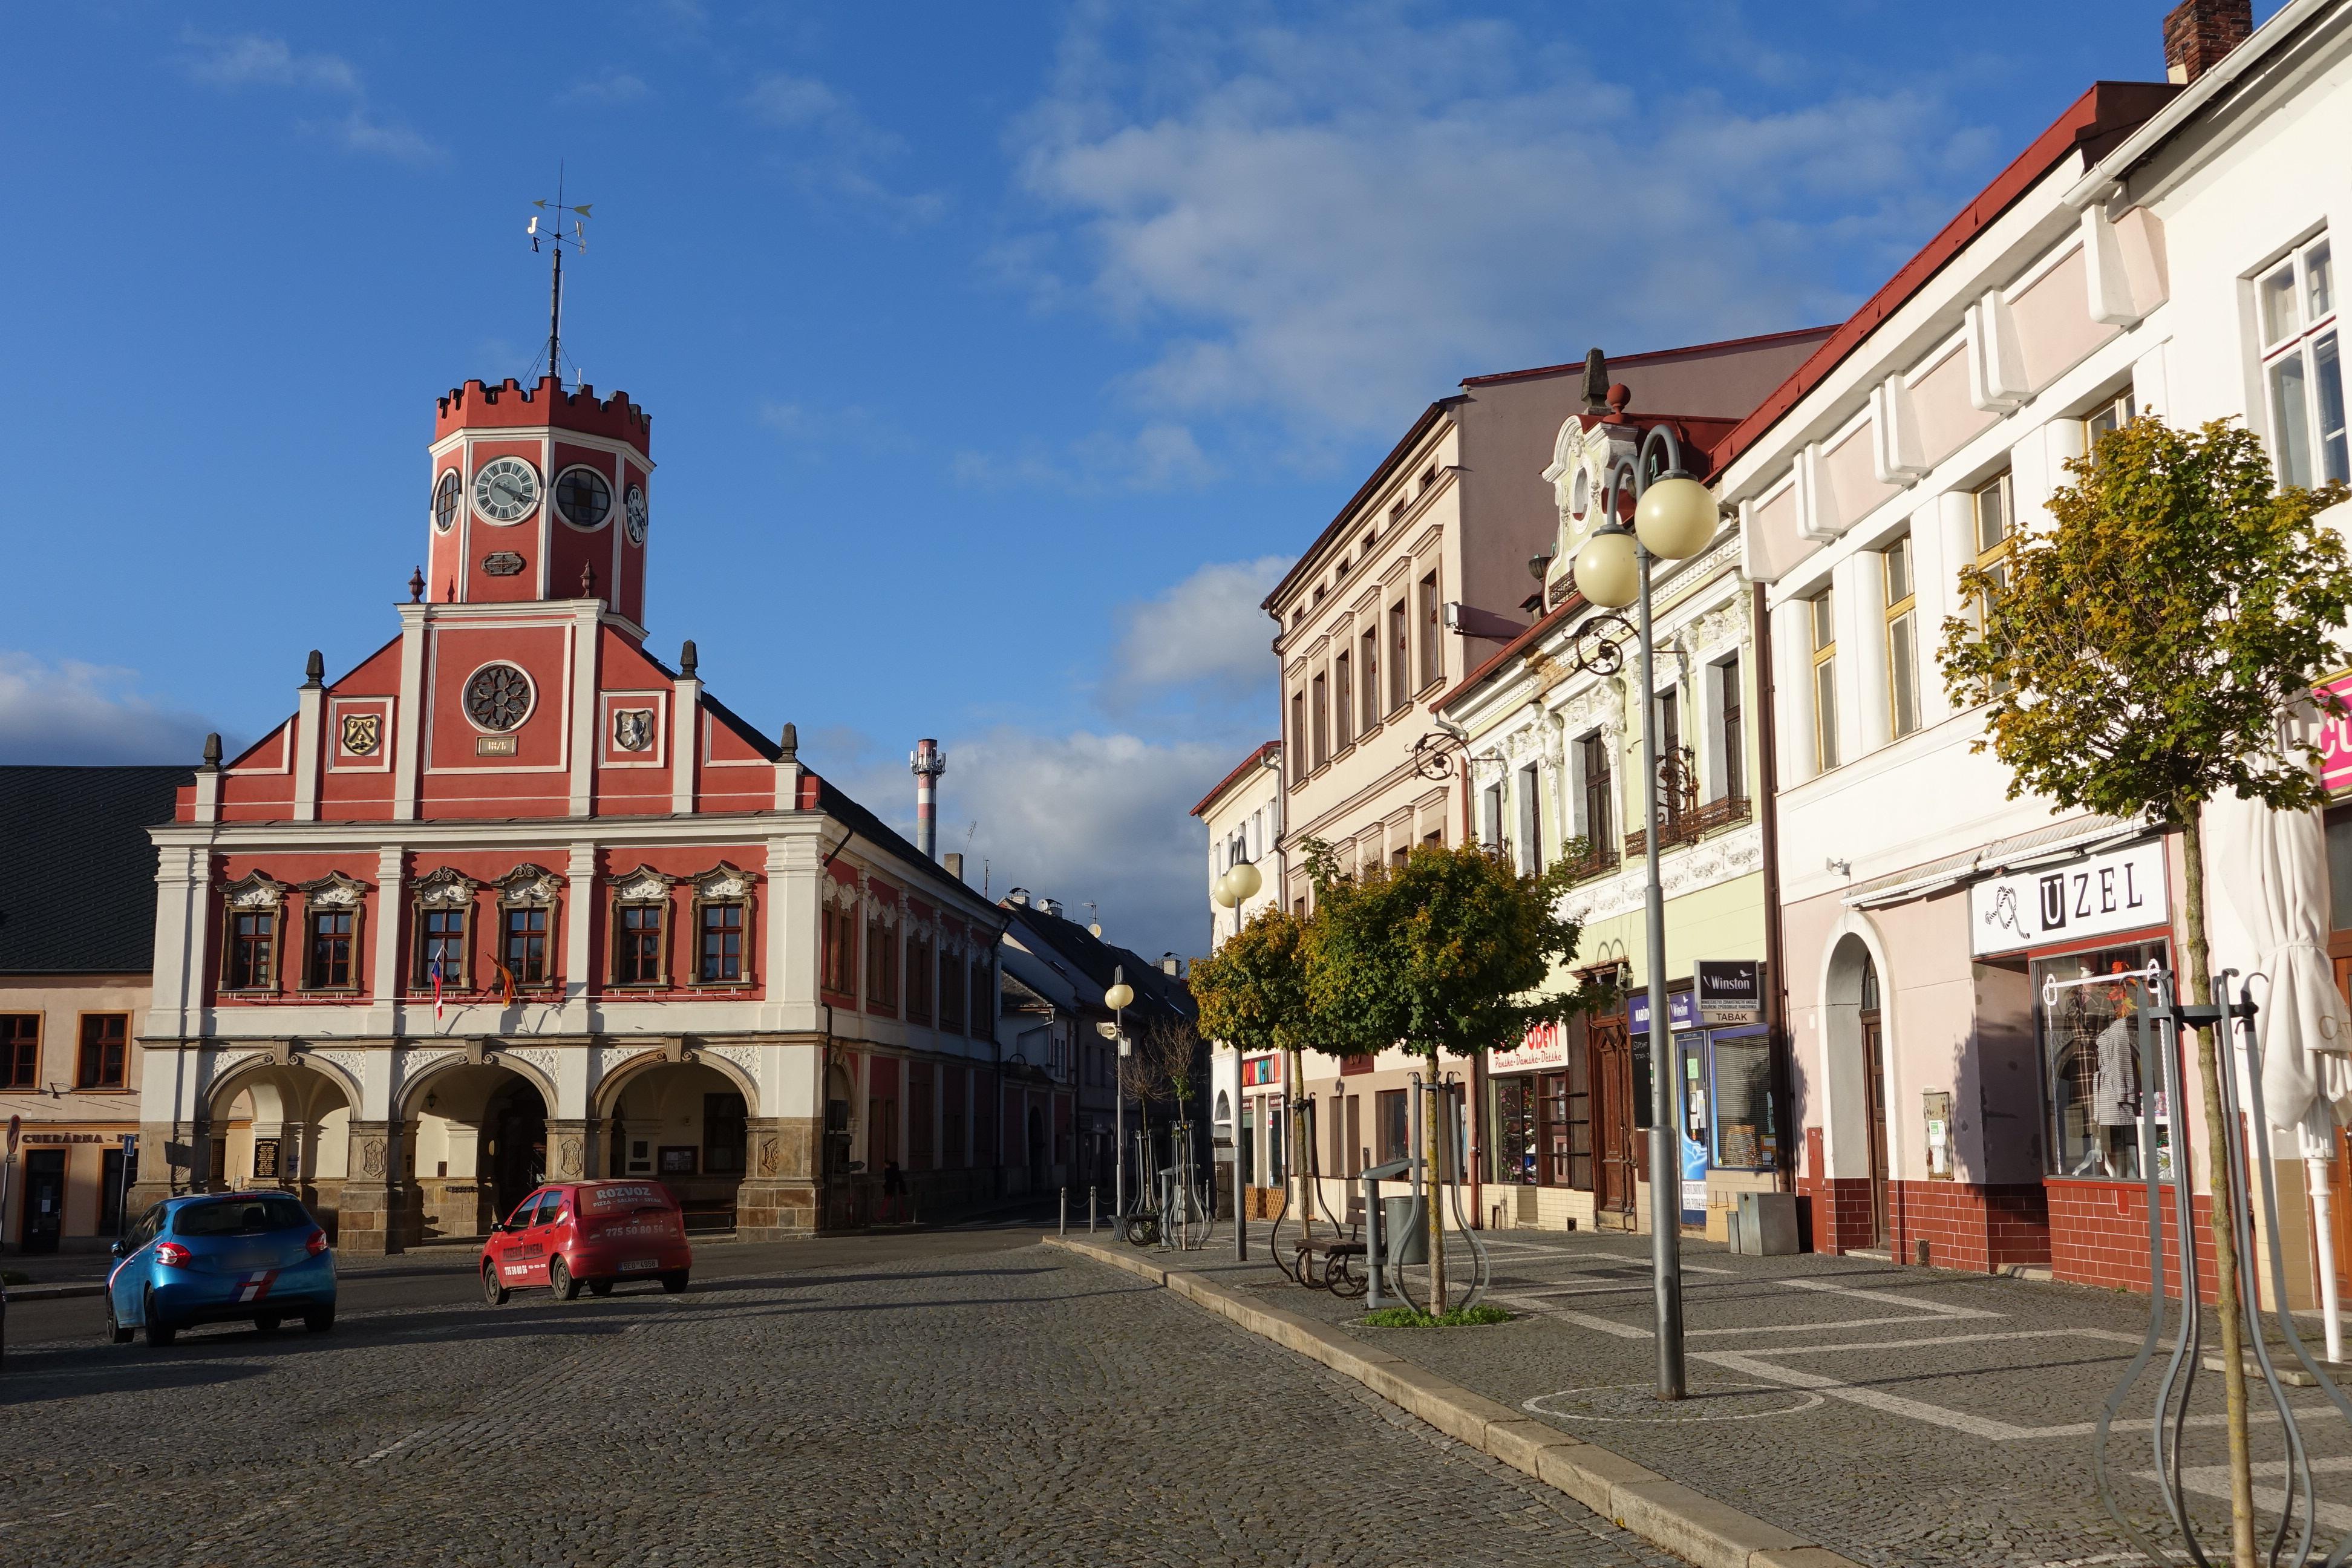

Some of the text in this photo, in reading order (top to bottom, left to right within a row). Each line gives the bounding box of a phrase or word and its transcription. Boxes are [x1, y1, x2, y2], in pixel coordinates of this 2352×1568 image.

[528, 217, 538, 234] J
[2042, 862, 2143, 925] UZEL
[1711, 975, 1750, 990] Winston
[1673, 1003, 1688, 1017] Winston
[1716, 1011, 1747, 1021] TABÁK
[1243, 1055, 1275, 1086] APÍRNICTVÍ
[22, 1132, 103, 1143] CUKRÁRNA
[596, 1187, 652, 1199] ROZVOZ
[606, 1225, 663, 1236] 775 50 80 56
